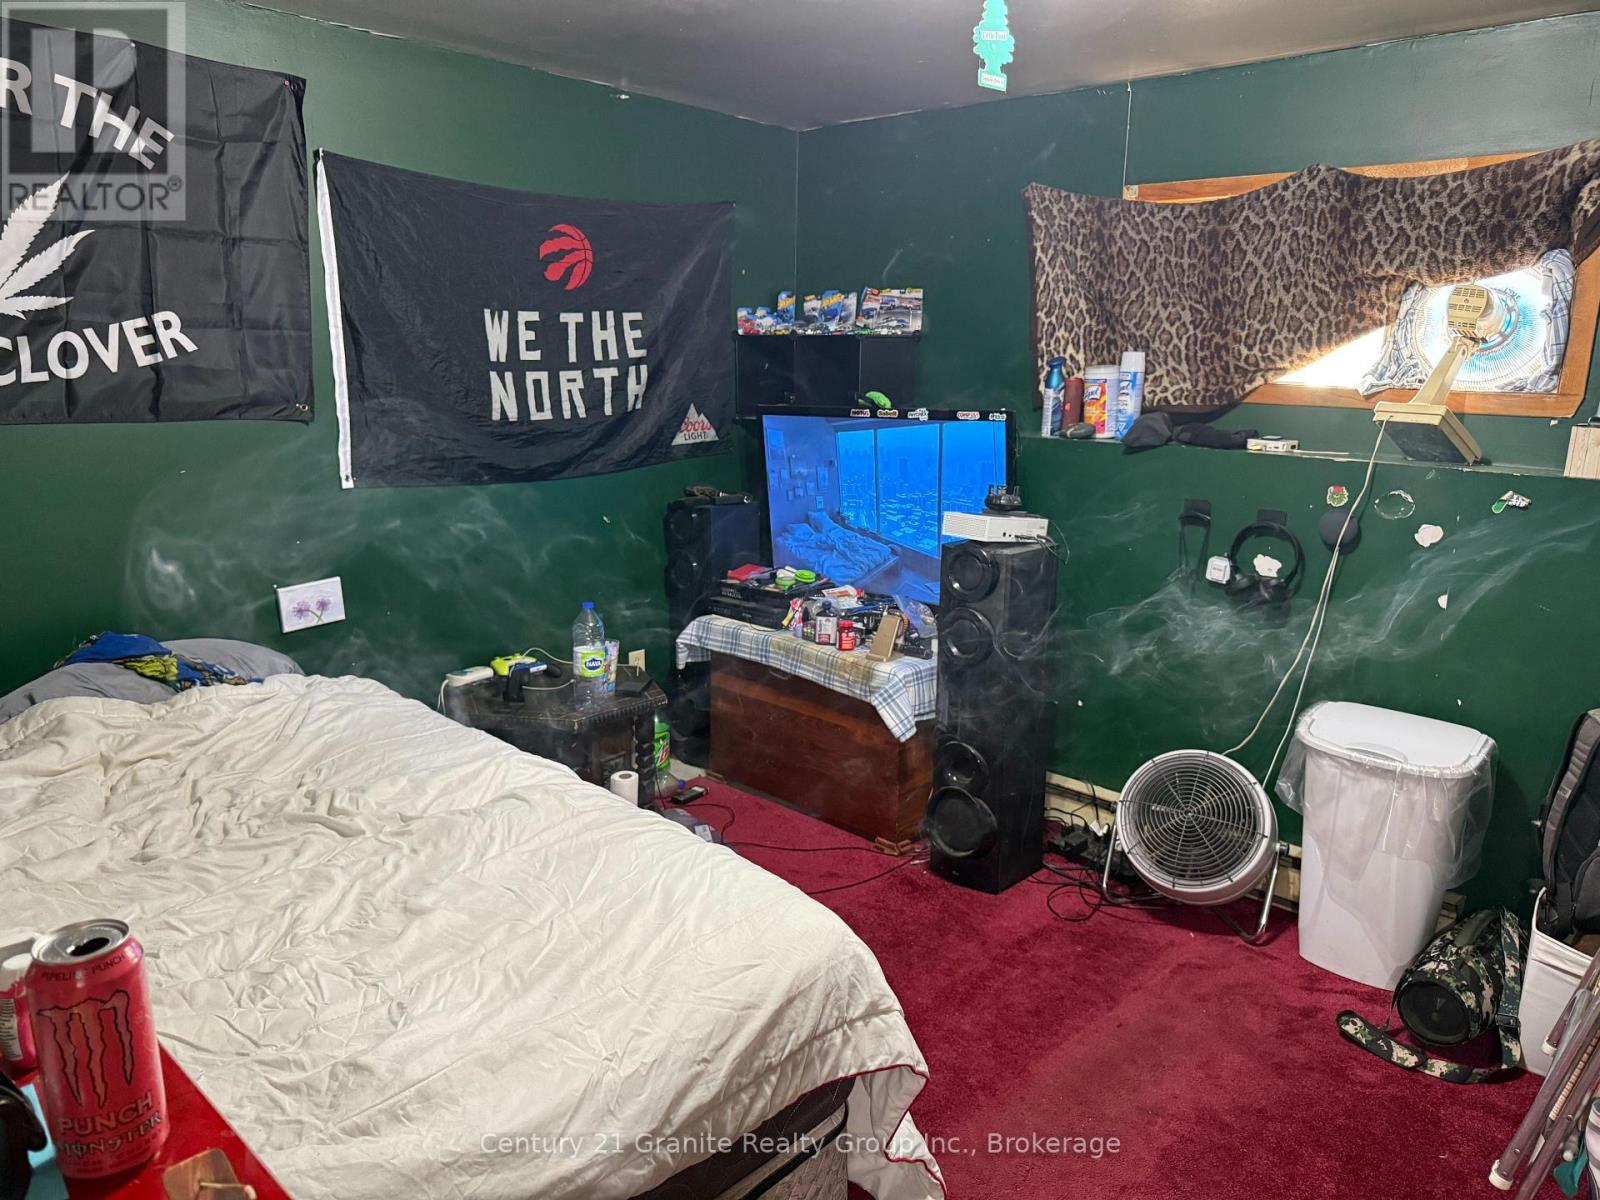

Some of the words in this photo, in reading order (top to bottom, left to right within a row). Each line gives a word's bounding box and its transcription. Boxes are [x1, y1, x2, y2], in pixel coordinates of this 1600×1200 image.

[54, 74, 175, 170] THE
[484, 308, 541, 362] WE
[559, 310, 647, 363] THE
[489, 364, 648, 421] NORTH
[684, 432, 706, 440] LIGHT
[57, 1091, 153, 1135] PUNCH
